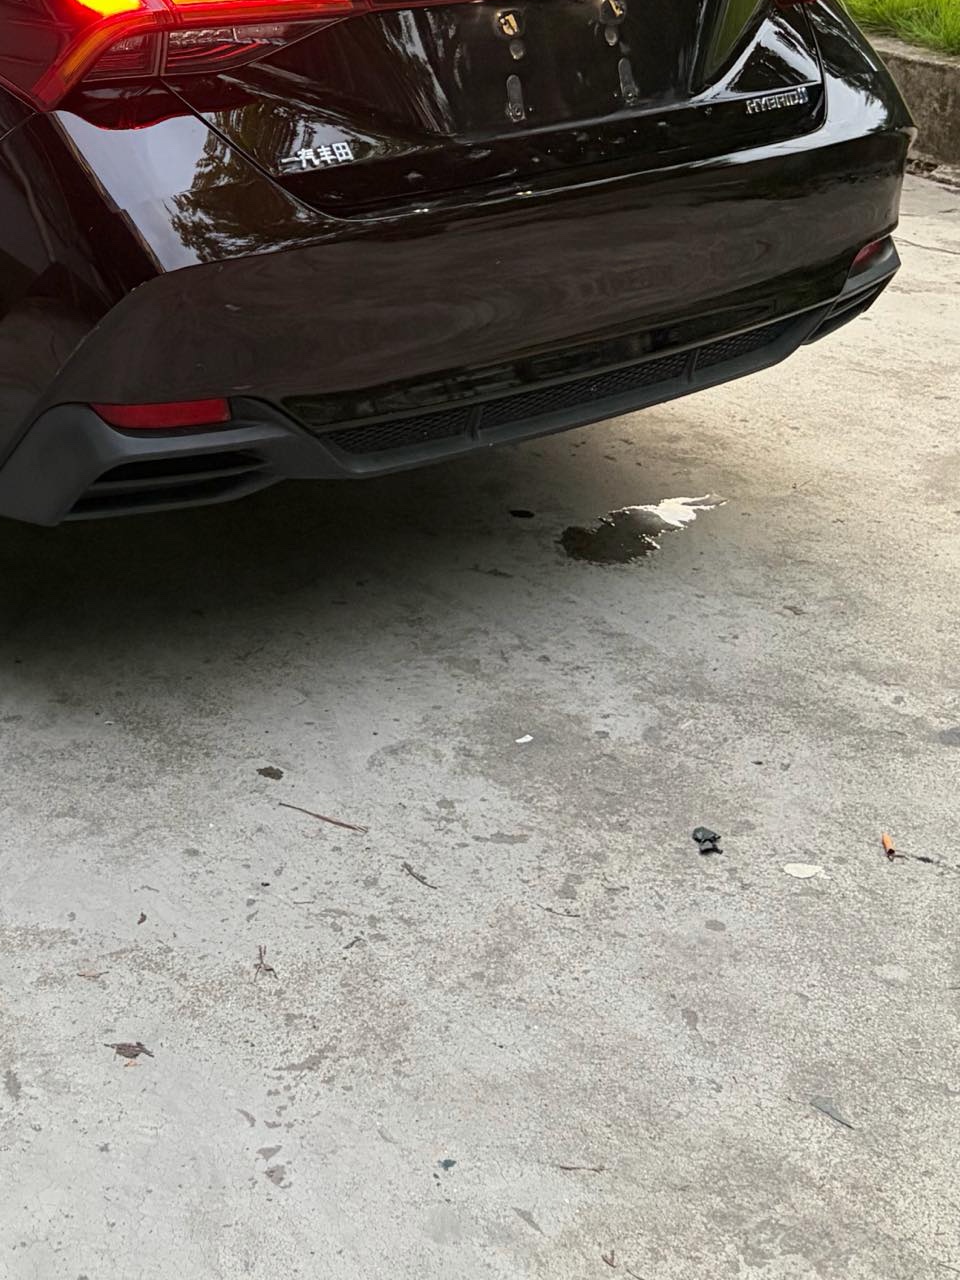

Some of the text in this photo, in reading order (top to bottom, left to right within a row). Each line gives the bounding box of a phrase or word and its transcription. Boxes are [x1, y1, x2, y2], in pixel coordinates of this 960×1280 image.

[746, 91, 799, 114] HYBRID
[281, 142, 354, 169] 一汽丰田
